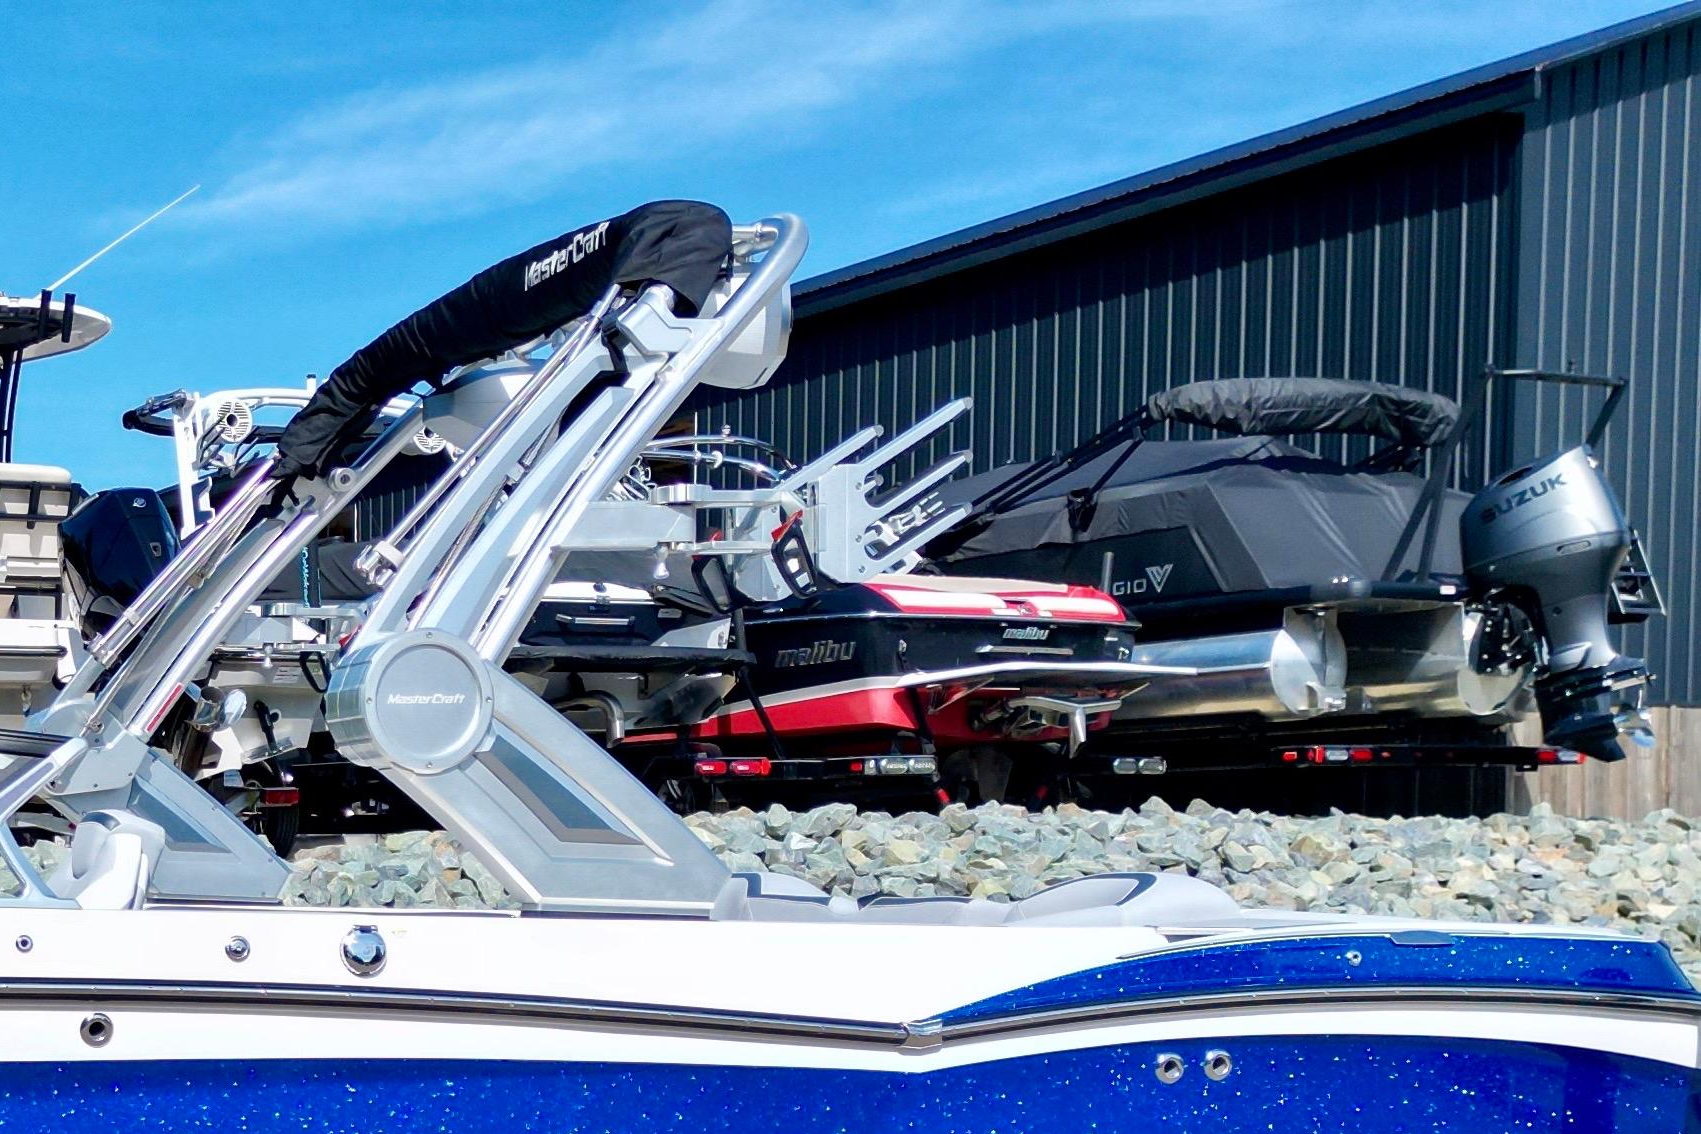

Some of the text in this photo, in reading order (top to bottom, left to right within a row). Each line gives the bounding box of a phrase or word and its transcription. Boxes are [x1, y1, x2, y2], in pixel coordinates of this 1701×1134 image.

[1481, 472, 1568, 525] SUZUK
[1002, 626, 1050, 640] malibu
[774, 640, 857, 668] malibu
[387, 693, 466, 704] MasterCraft
